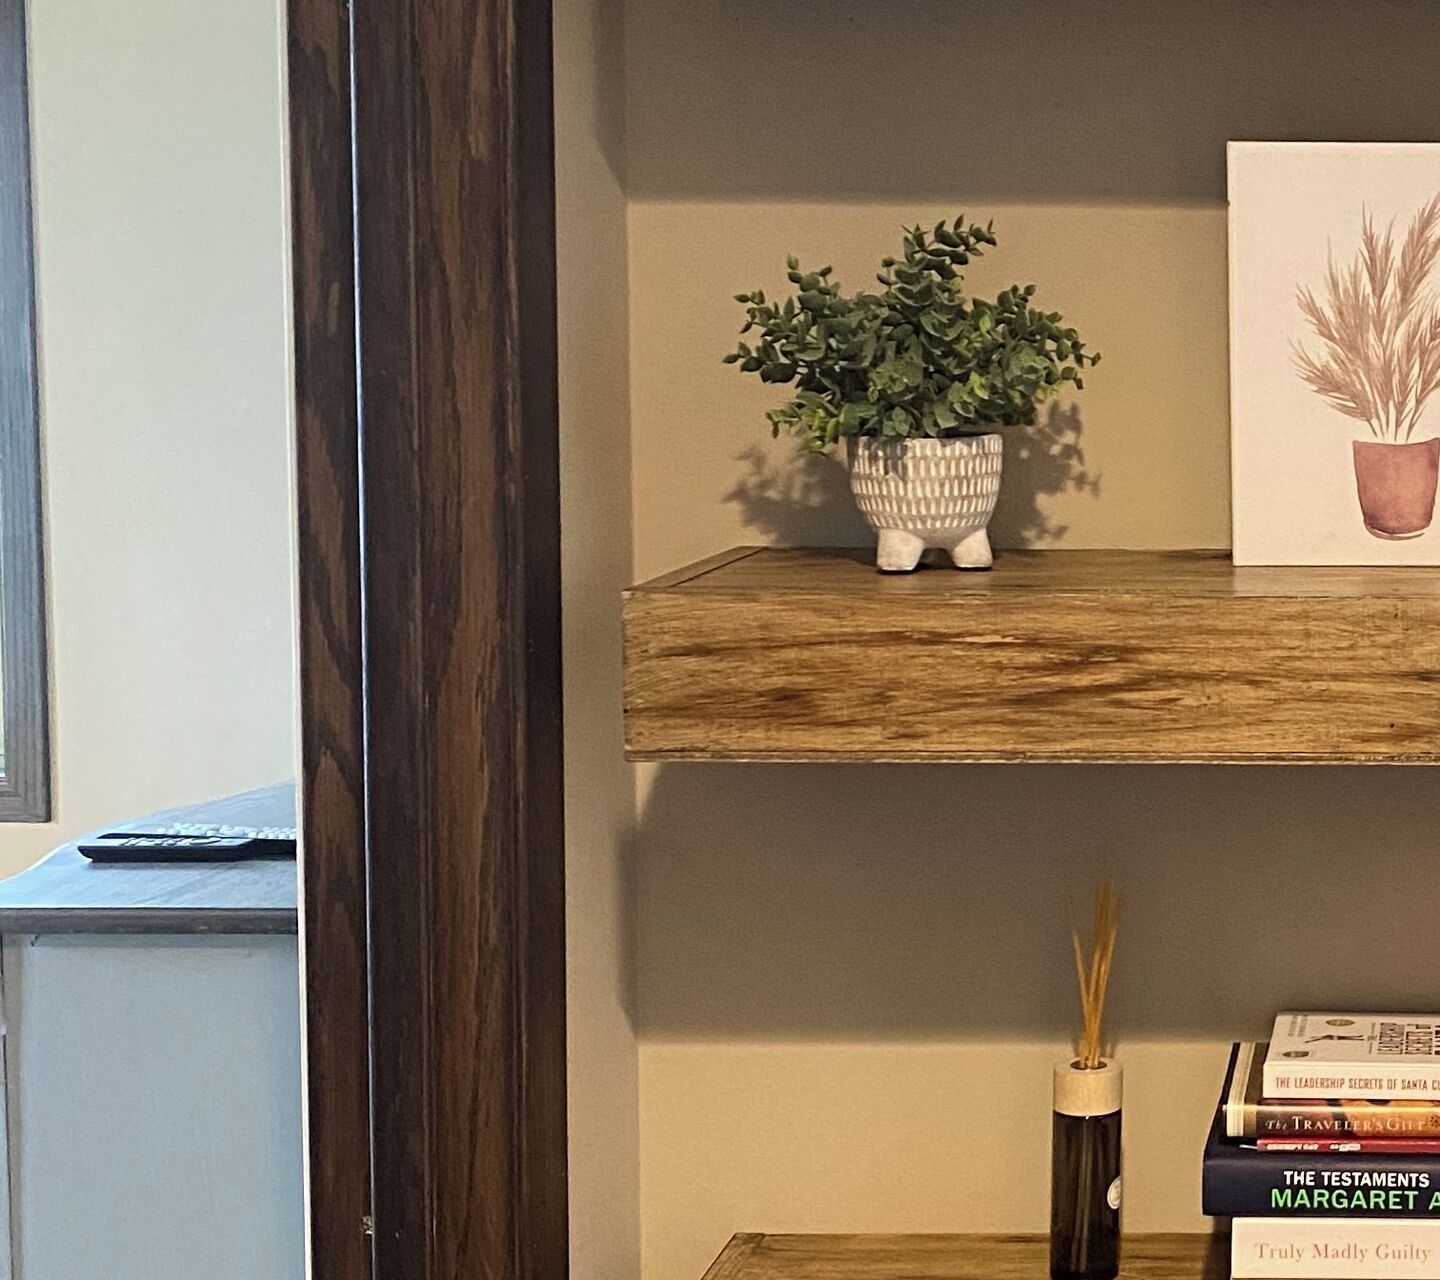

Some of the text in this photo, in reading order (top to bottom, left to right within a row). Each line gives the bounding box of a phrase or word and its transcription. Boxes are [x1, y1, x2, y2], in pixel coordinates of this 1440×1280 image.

[1275, 1077, 1291, 1089] THE
[1294, 1077, 1345, 1089] LEADERSHIP
[1348, 1078, 1383, 1090] SECRETS
[1387, 1078, 1397, 1090] OF
[1401, 1079, 1428, 1091] SANTA
[1265, 1119, 1288, 1130] The
[1292, 1115, 1384, 1132] TRAVELER'S
[1284, 1171, 1430, 1188] THE TESTAMENTS
[1271, 1189, 1419, 1210] MARGARET
[1254, 1243, 1431, 1263] Truly Madly Guilty
